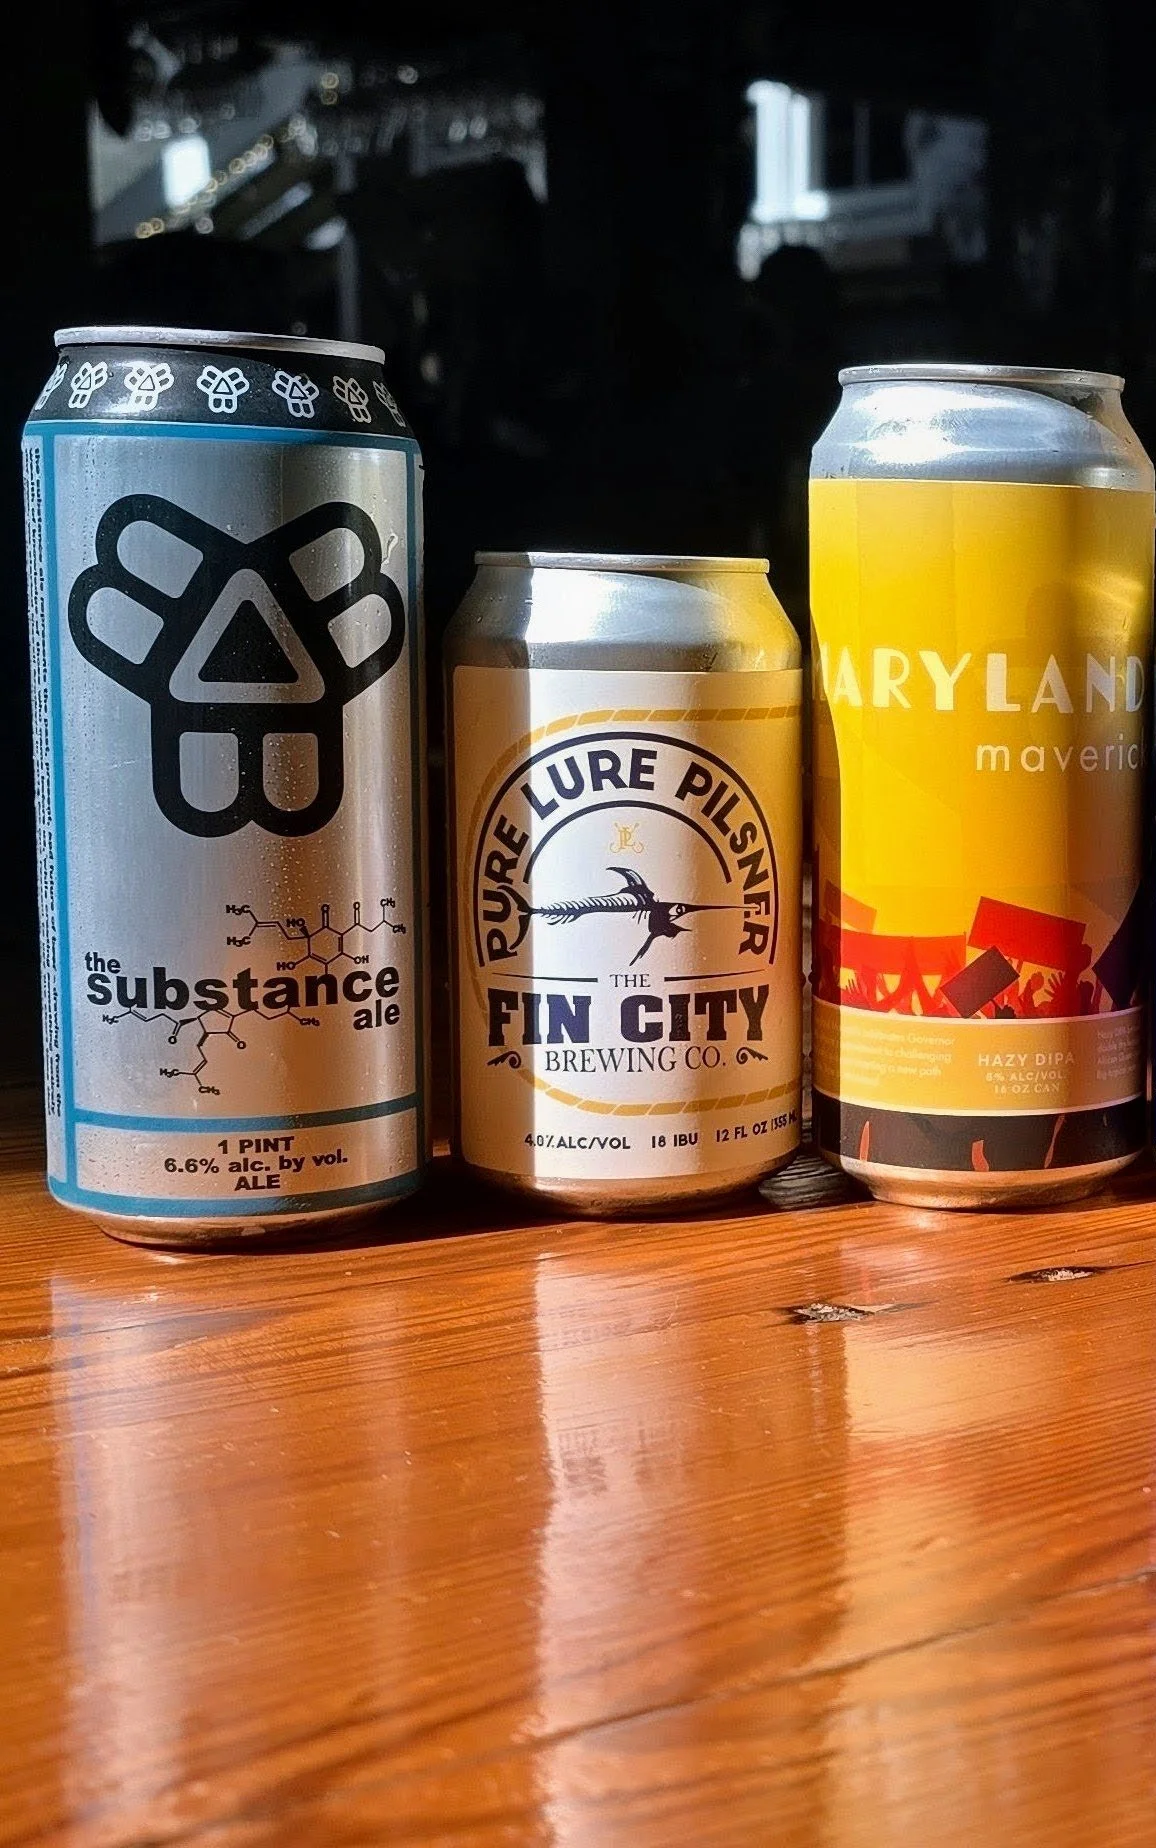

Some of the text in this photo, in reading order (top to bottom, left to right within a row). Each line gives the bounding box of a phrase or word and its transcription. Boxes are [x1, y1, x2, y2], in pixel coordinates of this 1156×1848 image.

[482, 748, 770, 962] PURE LURE PILSNER
[85, 951, 121, 975] the
[87, 964, 400, 1011] substance
[609, 973, 651, 988] THE
[353, 1000, 400, 1030] ale
[487, 984, 770, 1047] FIN CITY
[545, 1045, 726, 1073] BREWING CO.
[979, 1051, 1075, 1067] HAZY DIPA
[994, 1084, 1007, 1094] 16
[218, 1136, 295, 1154] 1 PINT
[652, 1135, 666, 1149] 18
[673, 1133, 699, 1147] IBU
[716, 1128, 730, 1143] 12
[734, 1125, 747, 1139] FL
[752, 1120, 768, 1135] OZ
[164, 1148, 348, 1174] 6.6% alc. by vol.
[234, 1175, 281, 1192] ALE
